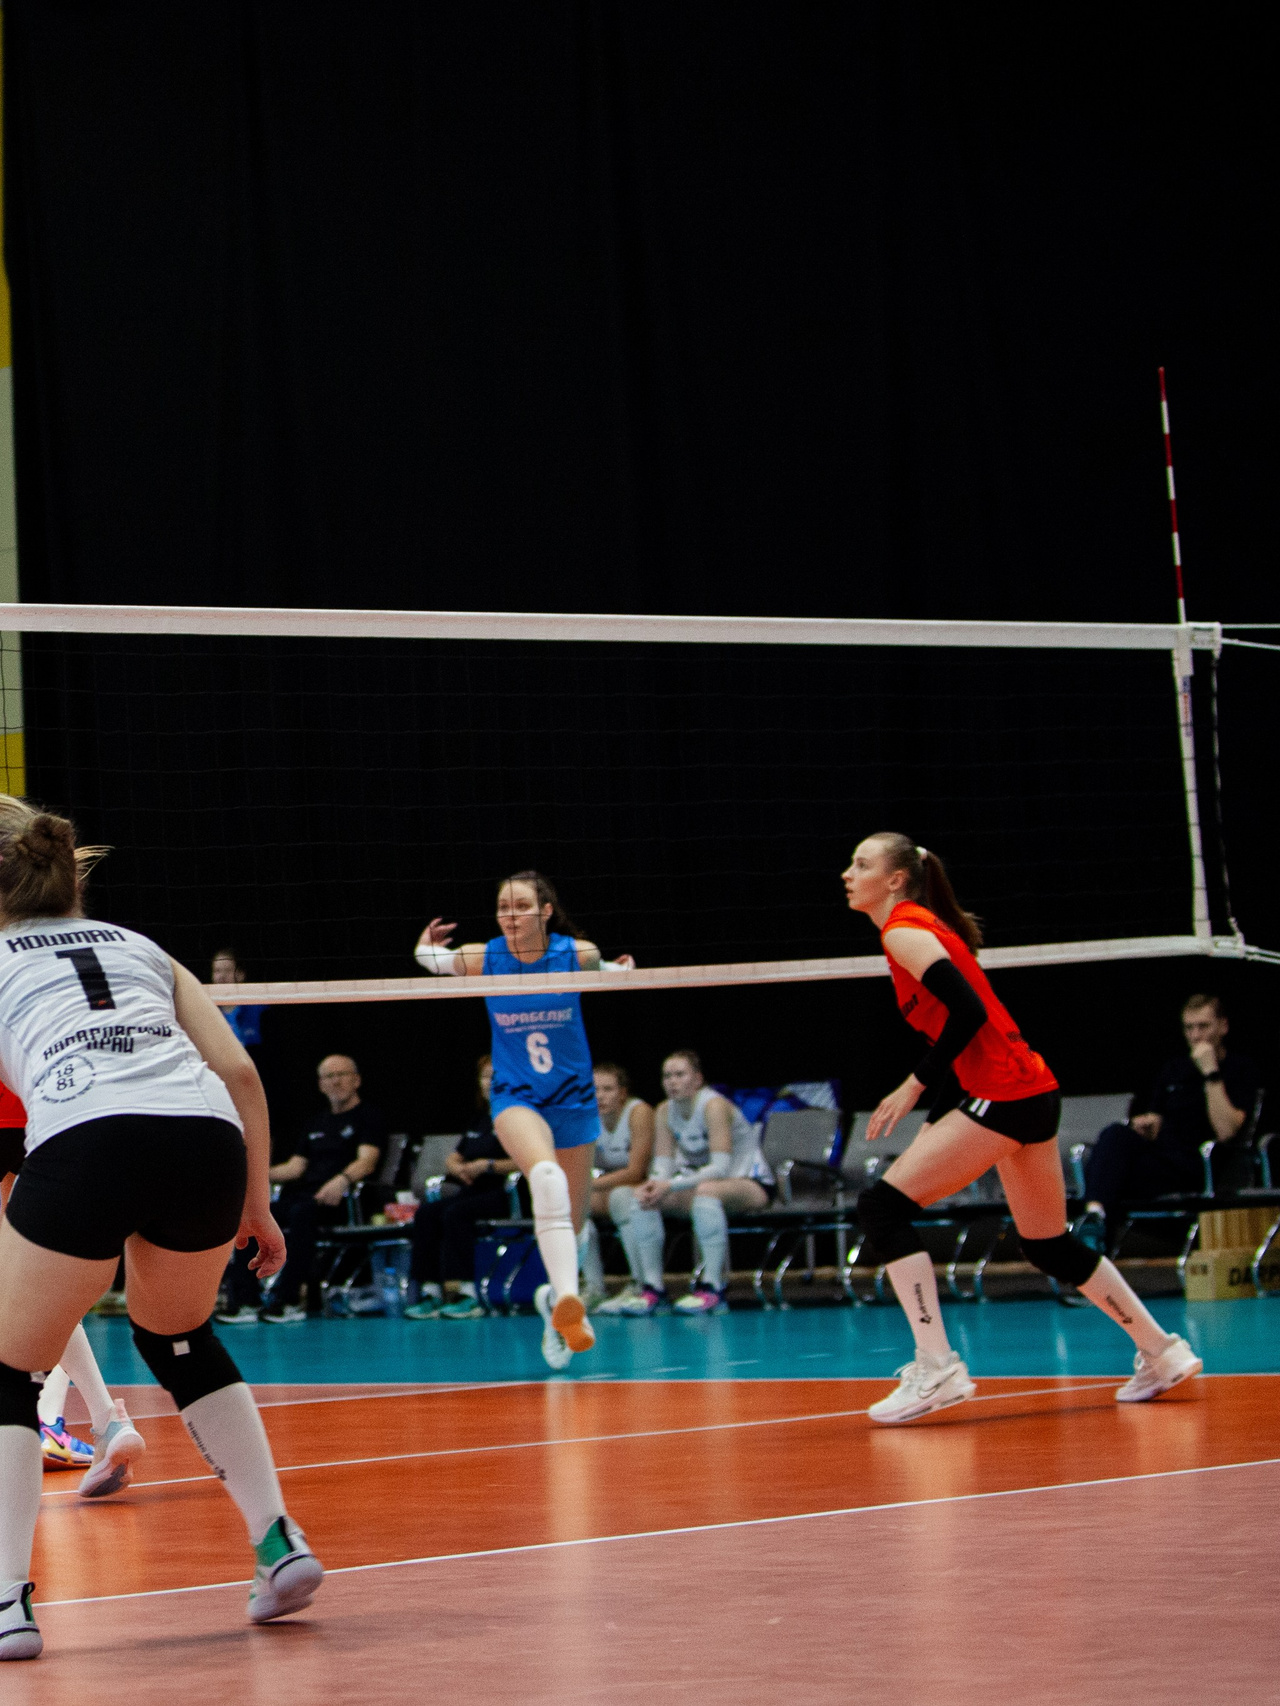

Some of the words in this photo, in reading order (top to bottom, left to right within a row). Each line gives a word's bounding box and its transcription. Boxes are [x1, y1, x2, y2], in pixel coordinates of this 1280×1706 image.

[55, 947, 116, 1010] 1
[526, 1031, 553, 1074] 6
[56, 1077, 76, 1091] 81
[57, 1063, 74, 1078] 18
